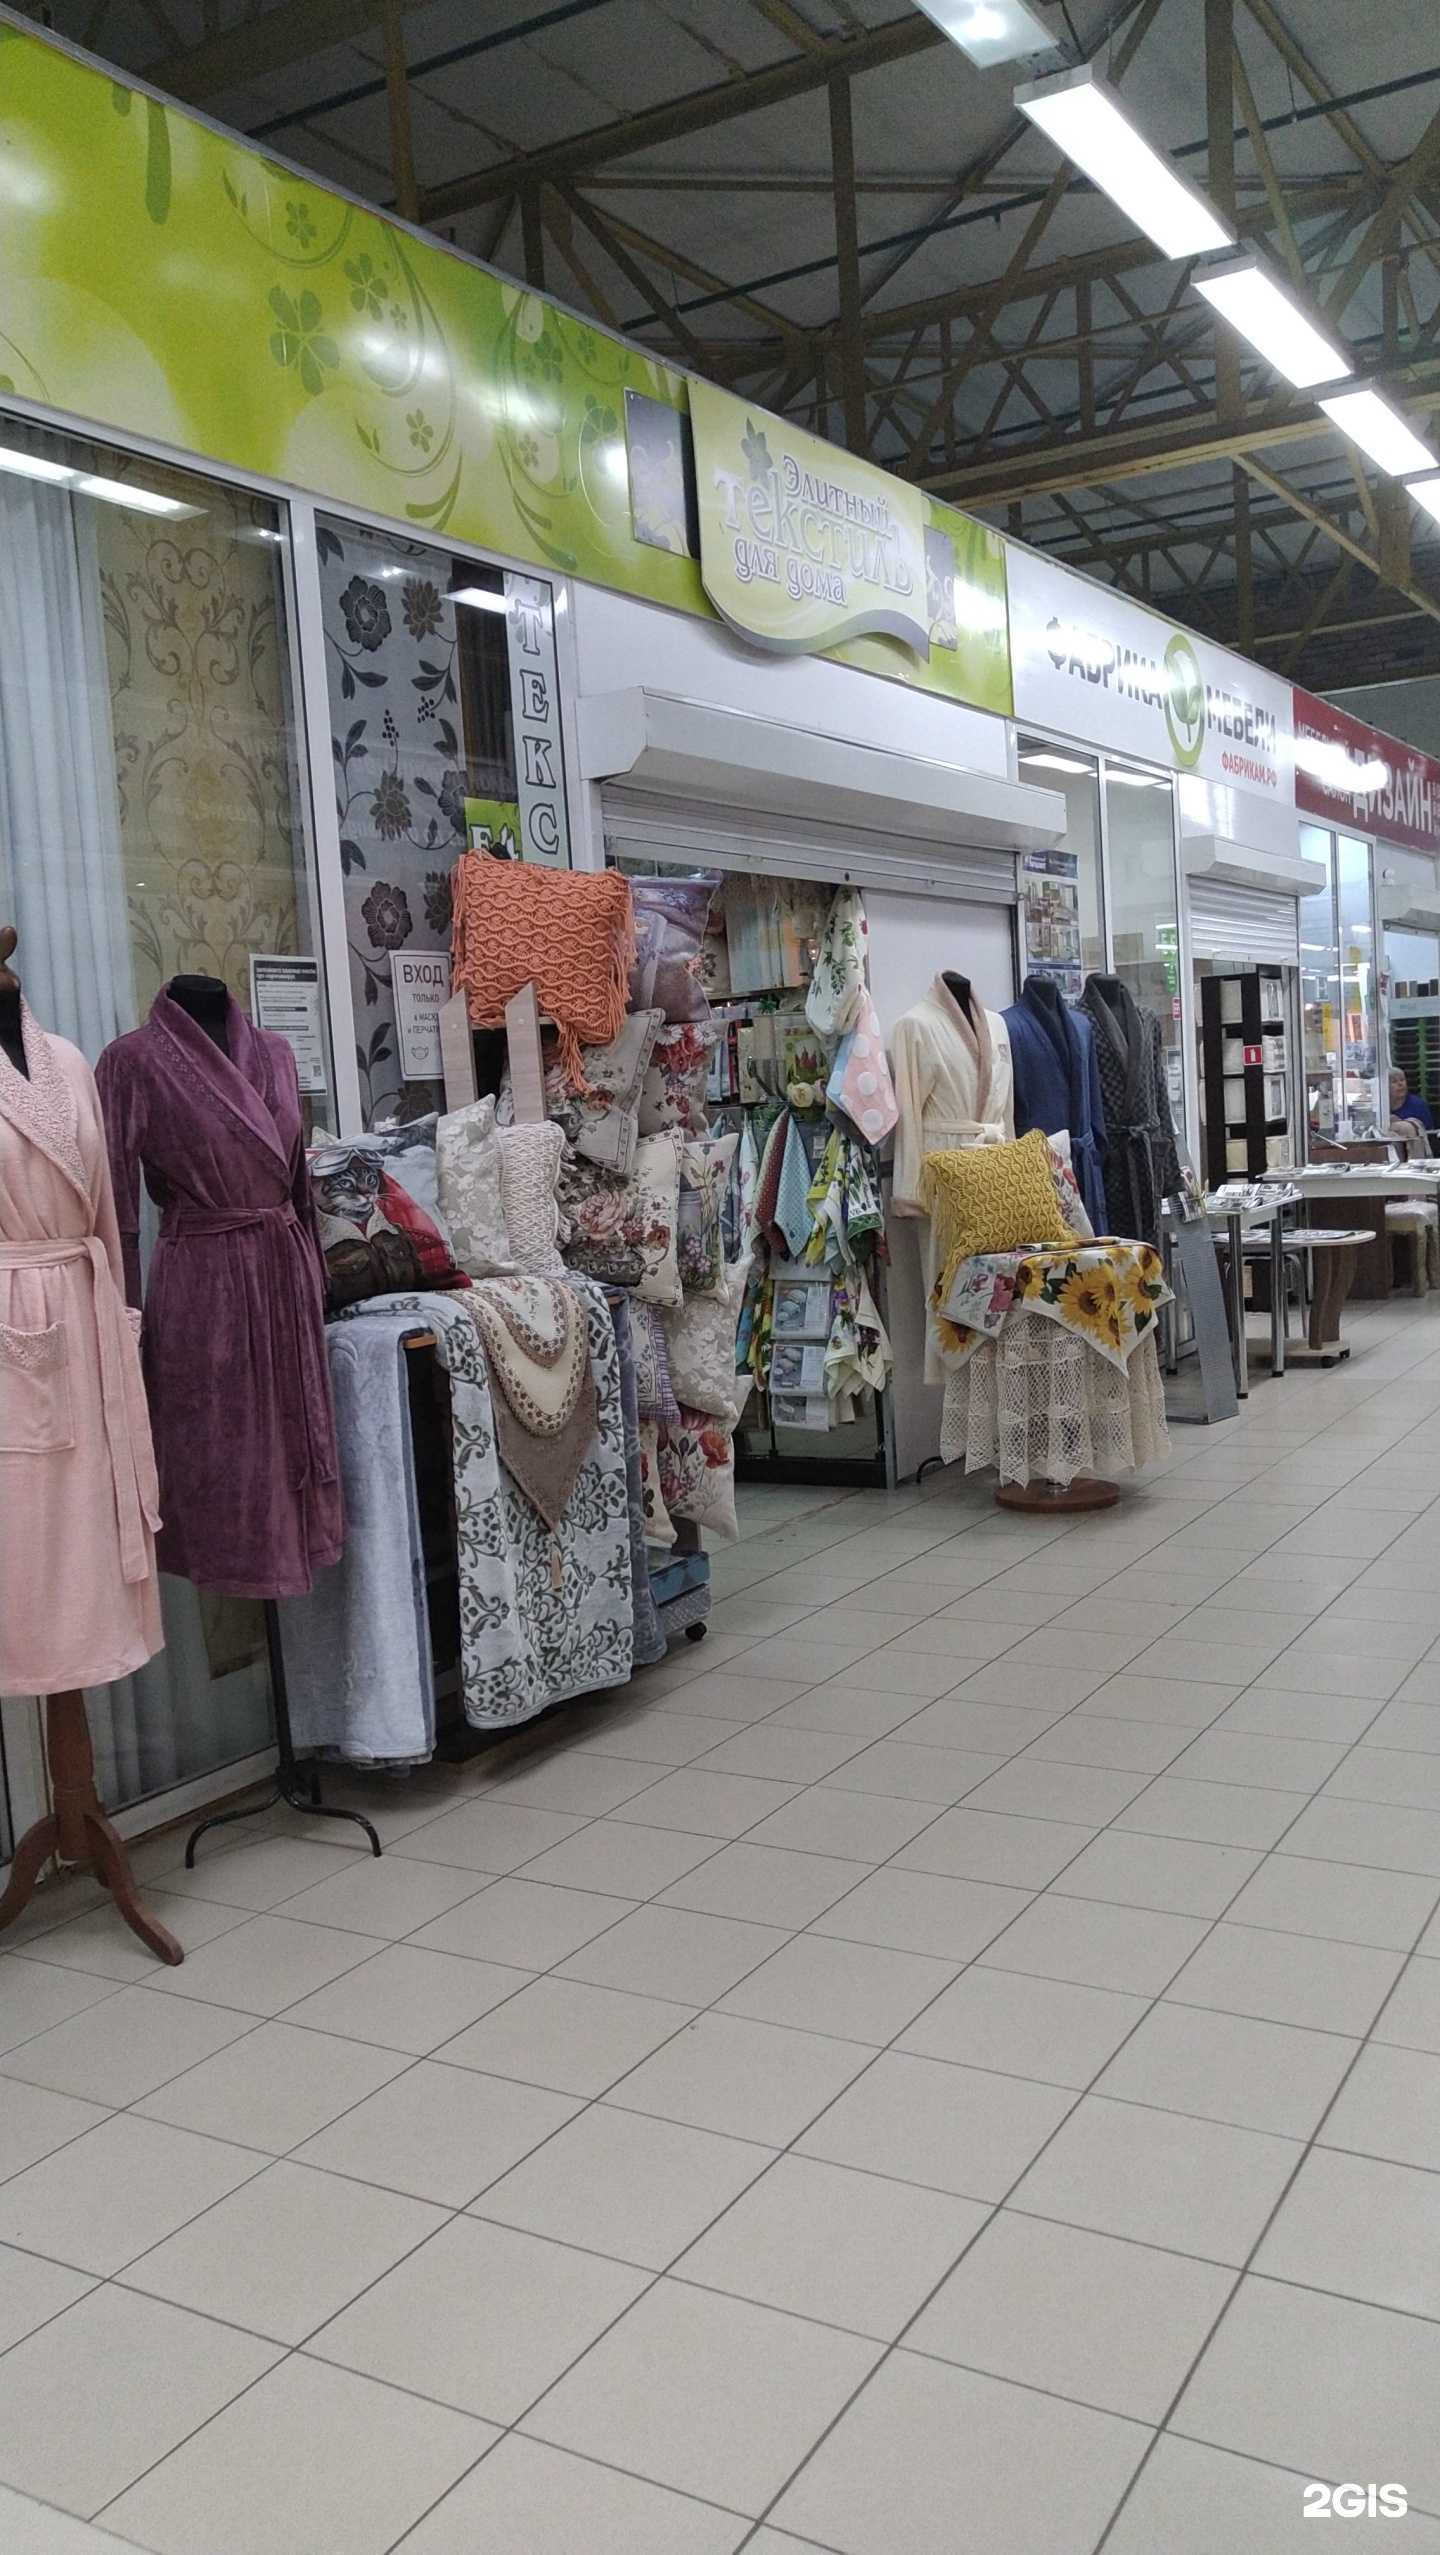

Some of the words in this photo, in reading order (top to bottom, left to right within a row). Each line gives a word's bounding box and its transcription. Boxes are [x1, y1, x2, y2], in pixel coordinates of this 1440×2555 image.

[783, 455, 890, 536] Элитный
[734, 537, 780, 583] для
[786, 556, 847, 607] дома
[1206, 685, 1277, 753] МЕБЕЛИ
[1221, 751, 1277, 788] ФАБРИКАМ.РФ
[403, 964, 443, 987] ВХОД
